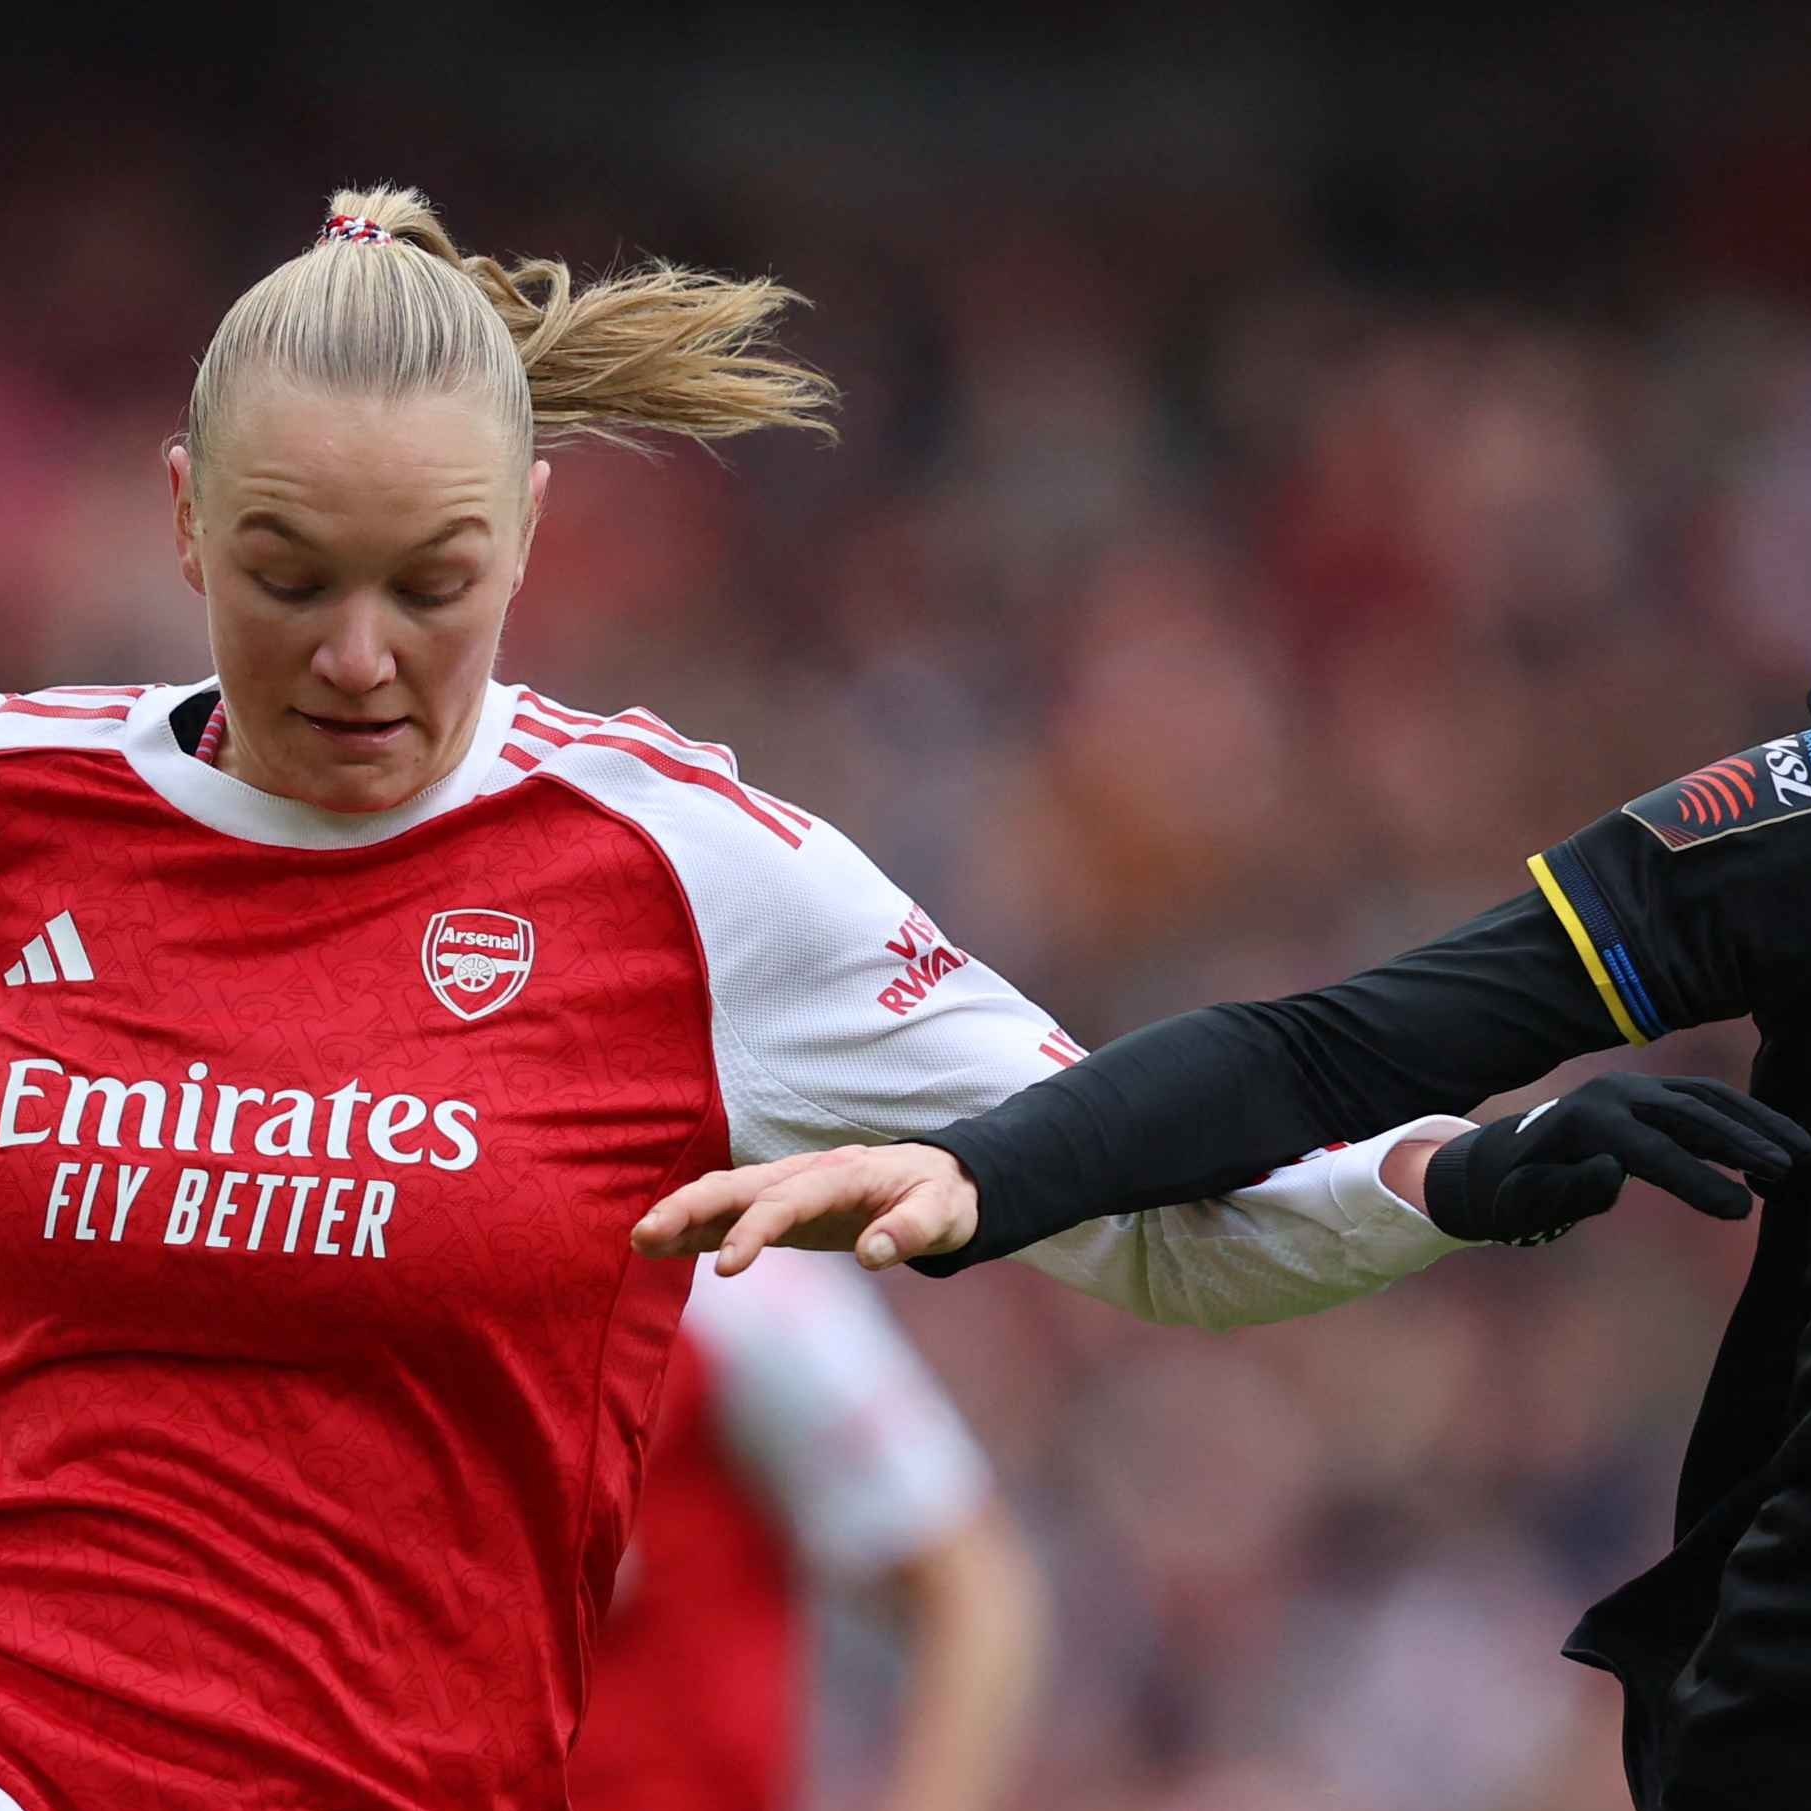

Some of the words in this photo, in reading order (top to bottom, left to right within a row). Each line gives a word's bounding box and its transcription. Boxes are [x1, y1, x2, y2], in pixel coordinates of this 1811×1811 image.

[439, 927, 519, 951] Arsenal
[876, 946, 969, 1016] RWA
[43, 1162, 150, 1242] FLY
[164, 1167, 396, 1260] BETTER
